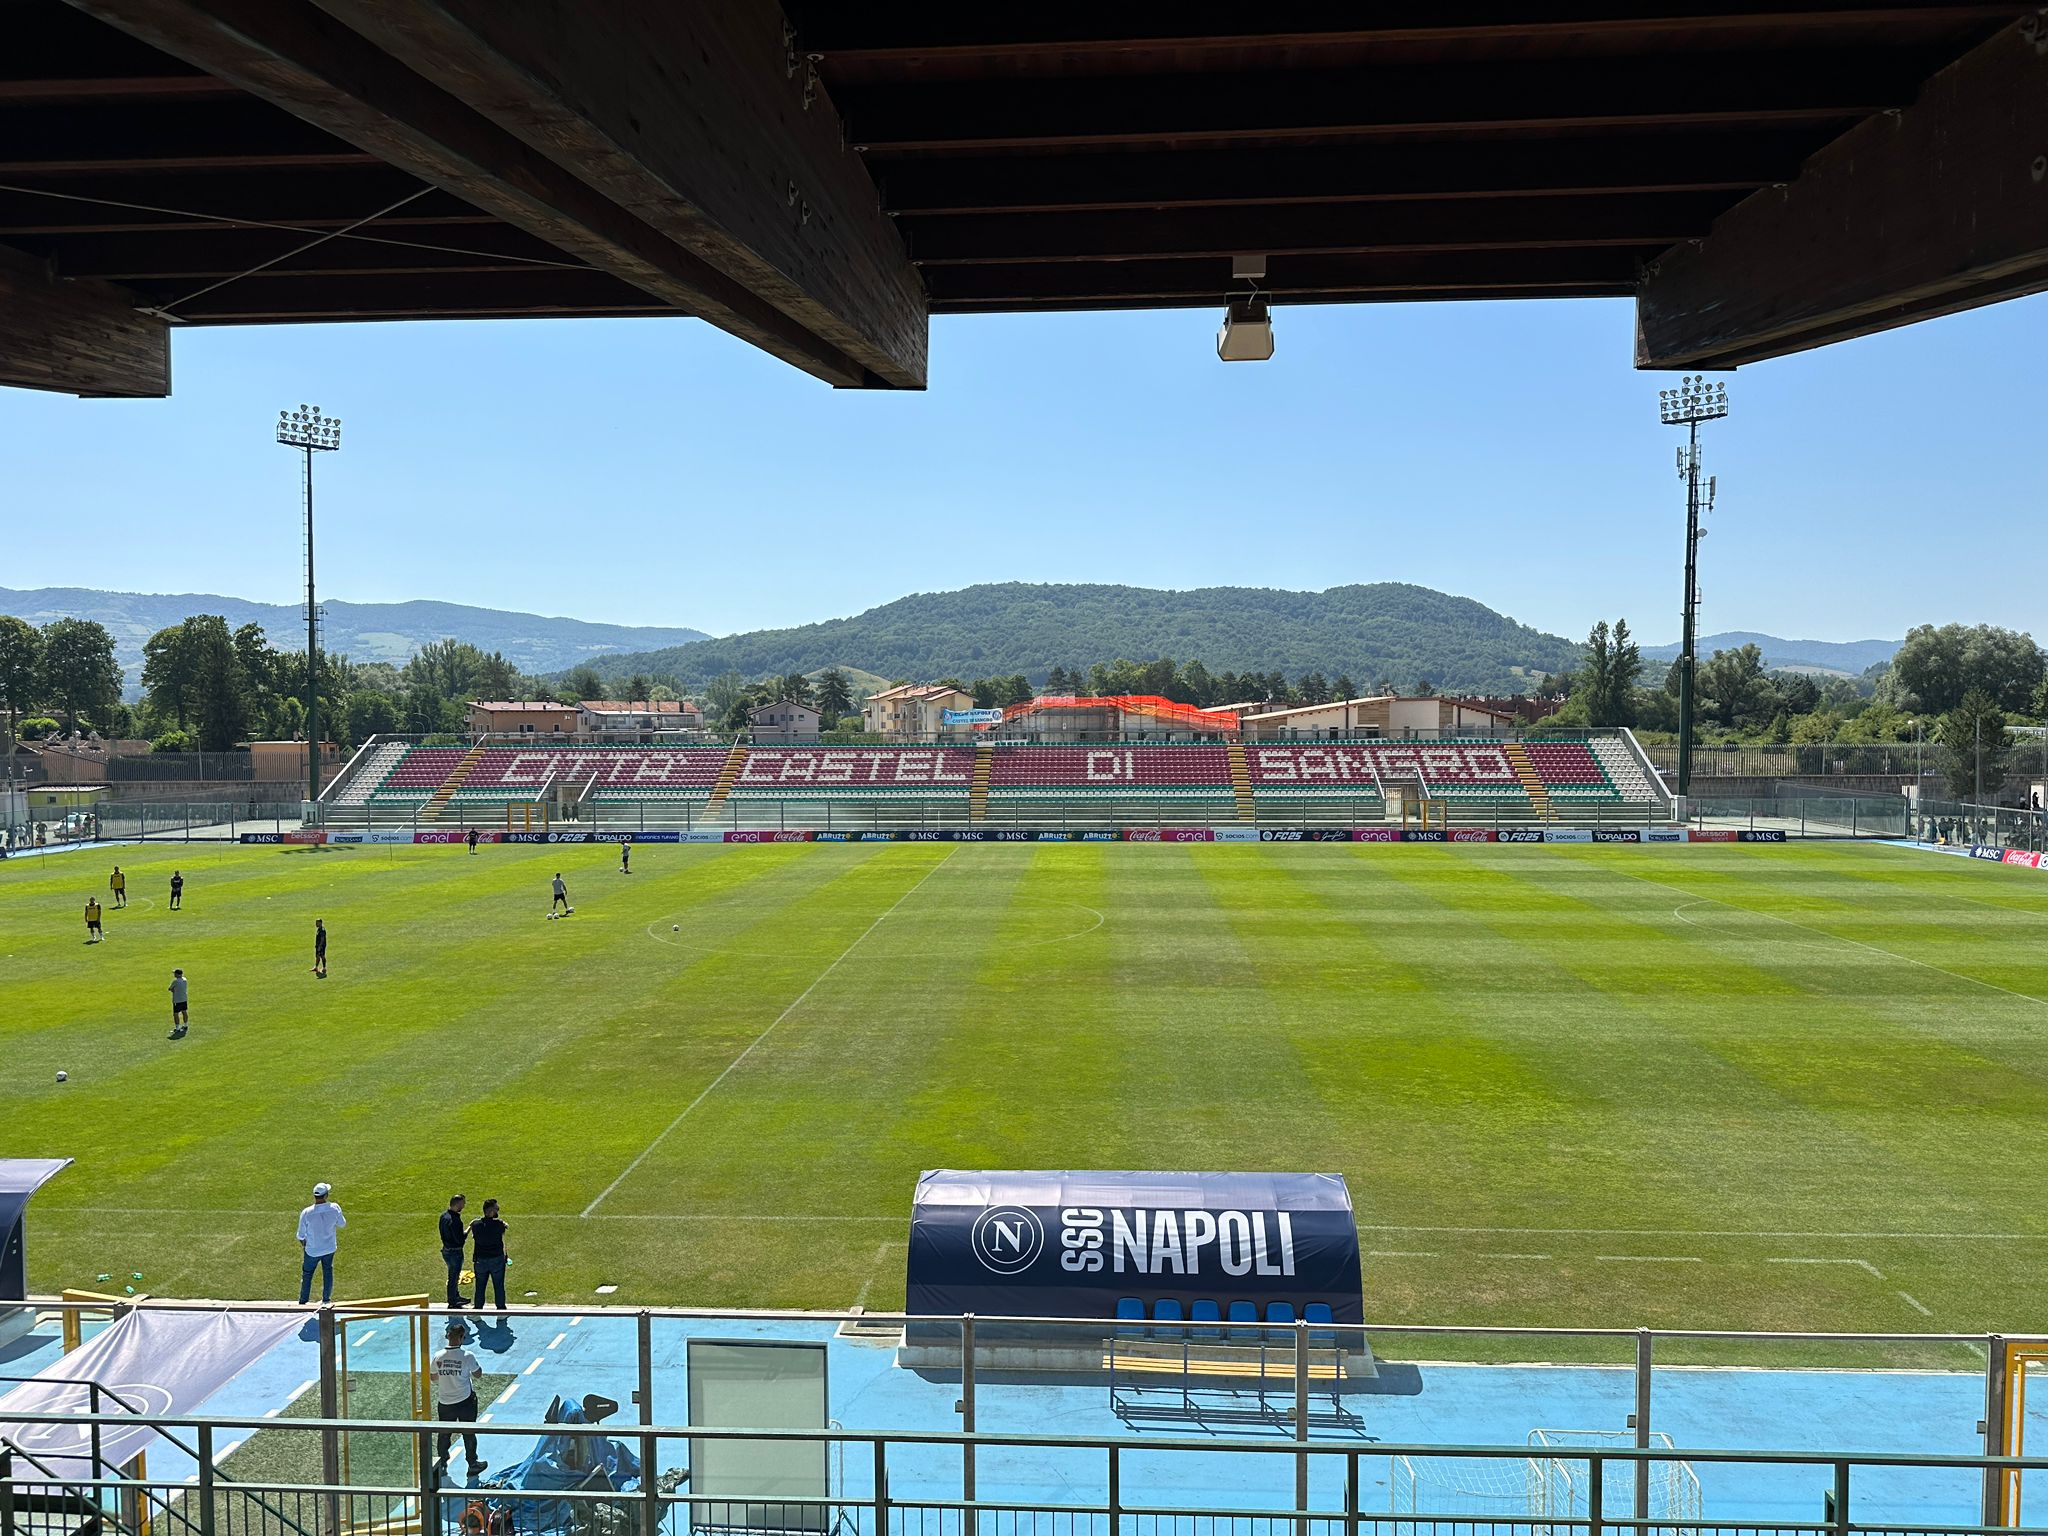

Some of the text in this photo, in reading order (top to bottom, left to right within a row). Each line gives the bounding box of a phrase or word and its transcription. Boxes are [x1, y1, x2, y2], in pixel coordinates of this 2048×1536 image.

[740, 752, 967, 782] CASTEL
[1087, 751, 1134, 780] DI
[1259, 750, 1513, 779] SANGRO
[256, 834, 278, 843] MSC
[420, 833, 449, 843] enel
[518, 834, 541, 842] MSC
[731, 832, 760, 842] enel
[1176, 831, 1206, 841] enel
[1360, 831, 1391, 841] enel
[1418, 832, 1441, 841] MSC
[1756, 832, 1780, 841] MSC
[1981, 848, 2000, 859] MSC
[991, 1220, 1024, 1253] N
[1061, 1208, 1104, 1272] SSC
[1112, 1209, 1296, 1277] NAPOLI
